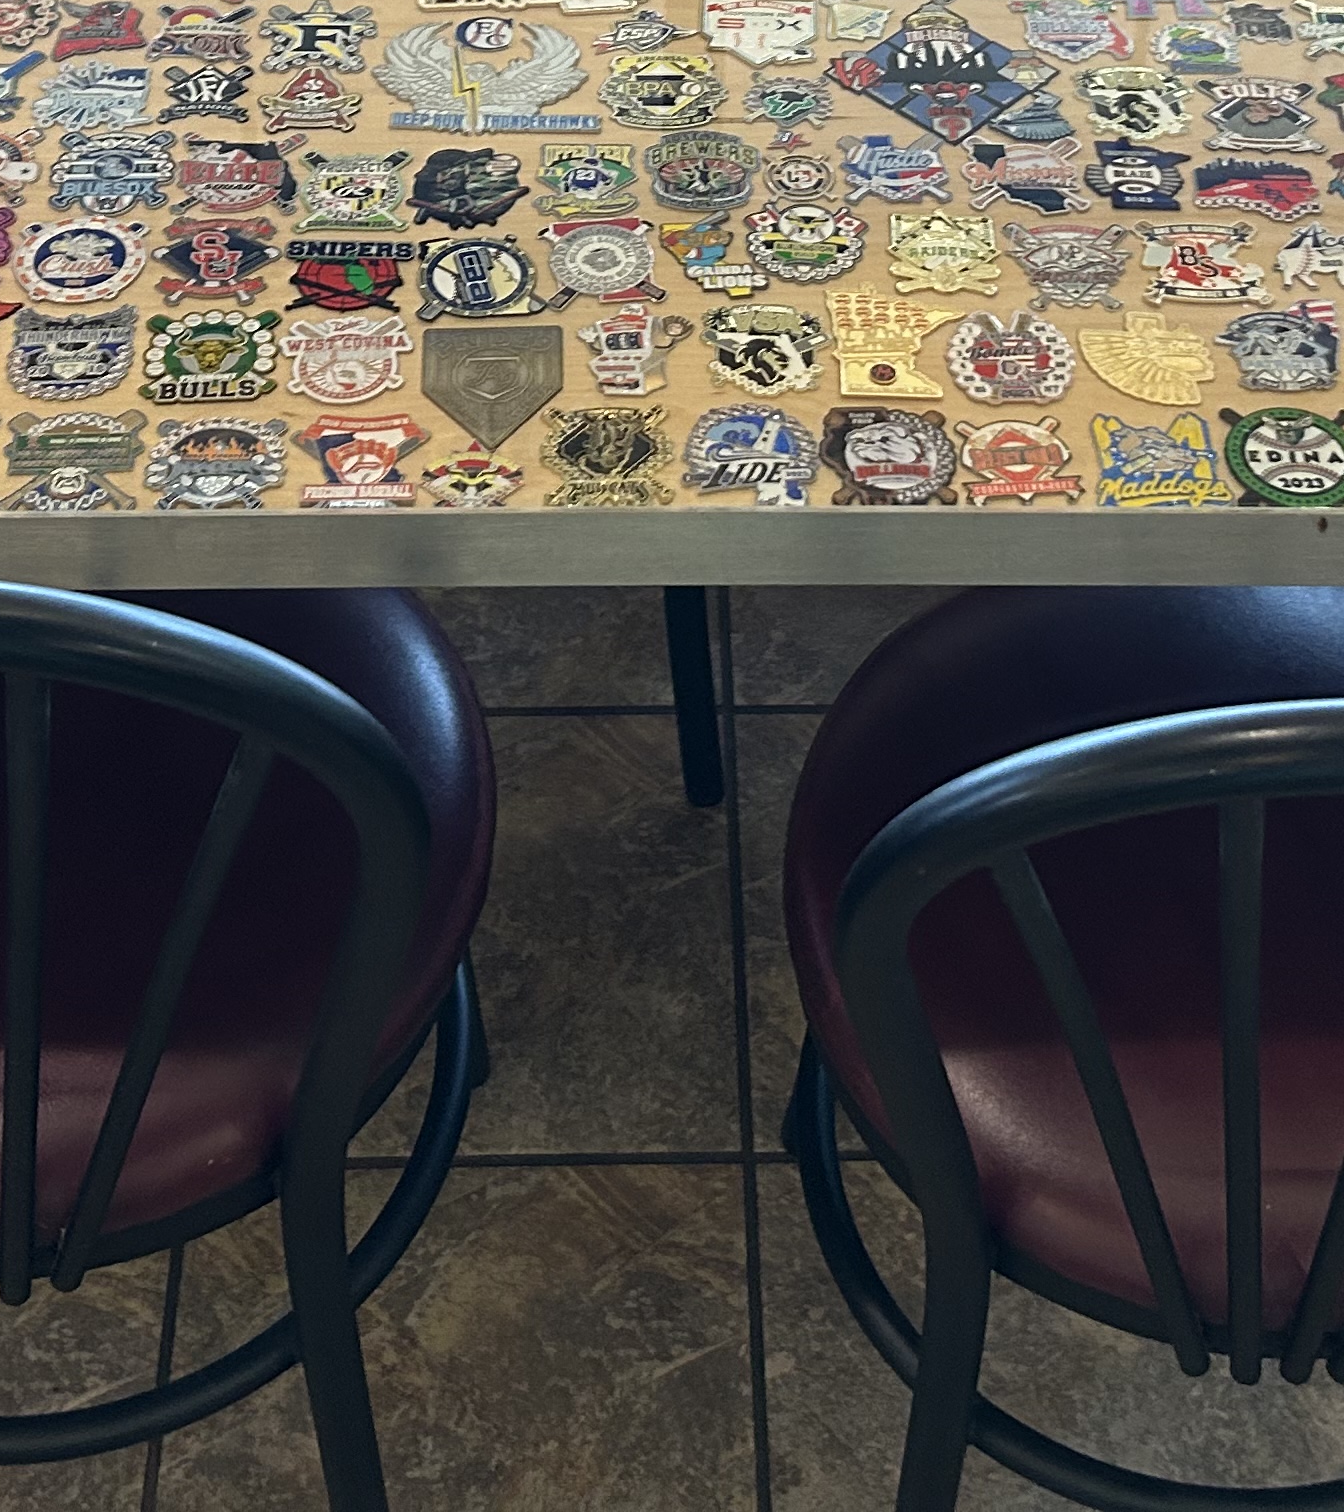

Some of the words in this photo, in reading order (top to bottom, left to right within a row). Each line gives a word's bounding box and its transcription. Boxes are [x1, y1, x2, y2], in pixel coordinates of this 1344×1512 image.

[626, 79, 674, 98] BPA
[1217, 85, 1299, 100] COLTS
[651, 144, 754, 164] BREWERS
[287, 242, 413, 261] SNIPERS
[703, 274, 767, 290] LIONS
[287, 337, 335, 352] WEST
[159, 381, 255, 400] BULLS
[1249, 450, 1343, 465] EDINA
[705, 463, 782, 487] TIDE
[1278, 476, 1325, 488] 2023
[1099, 475, 1226, 505] Maddogs
